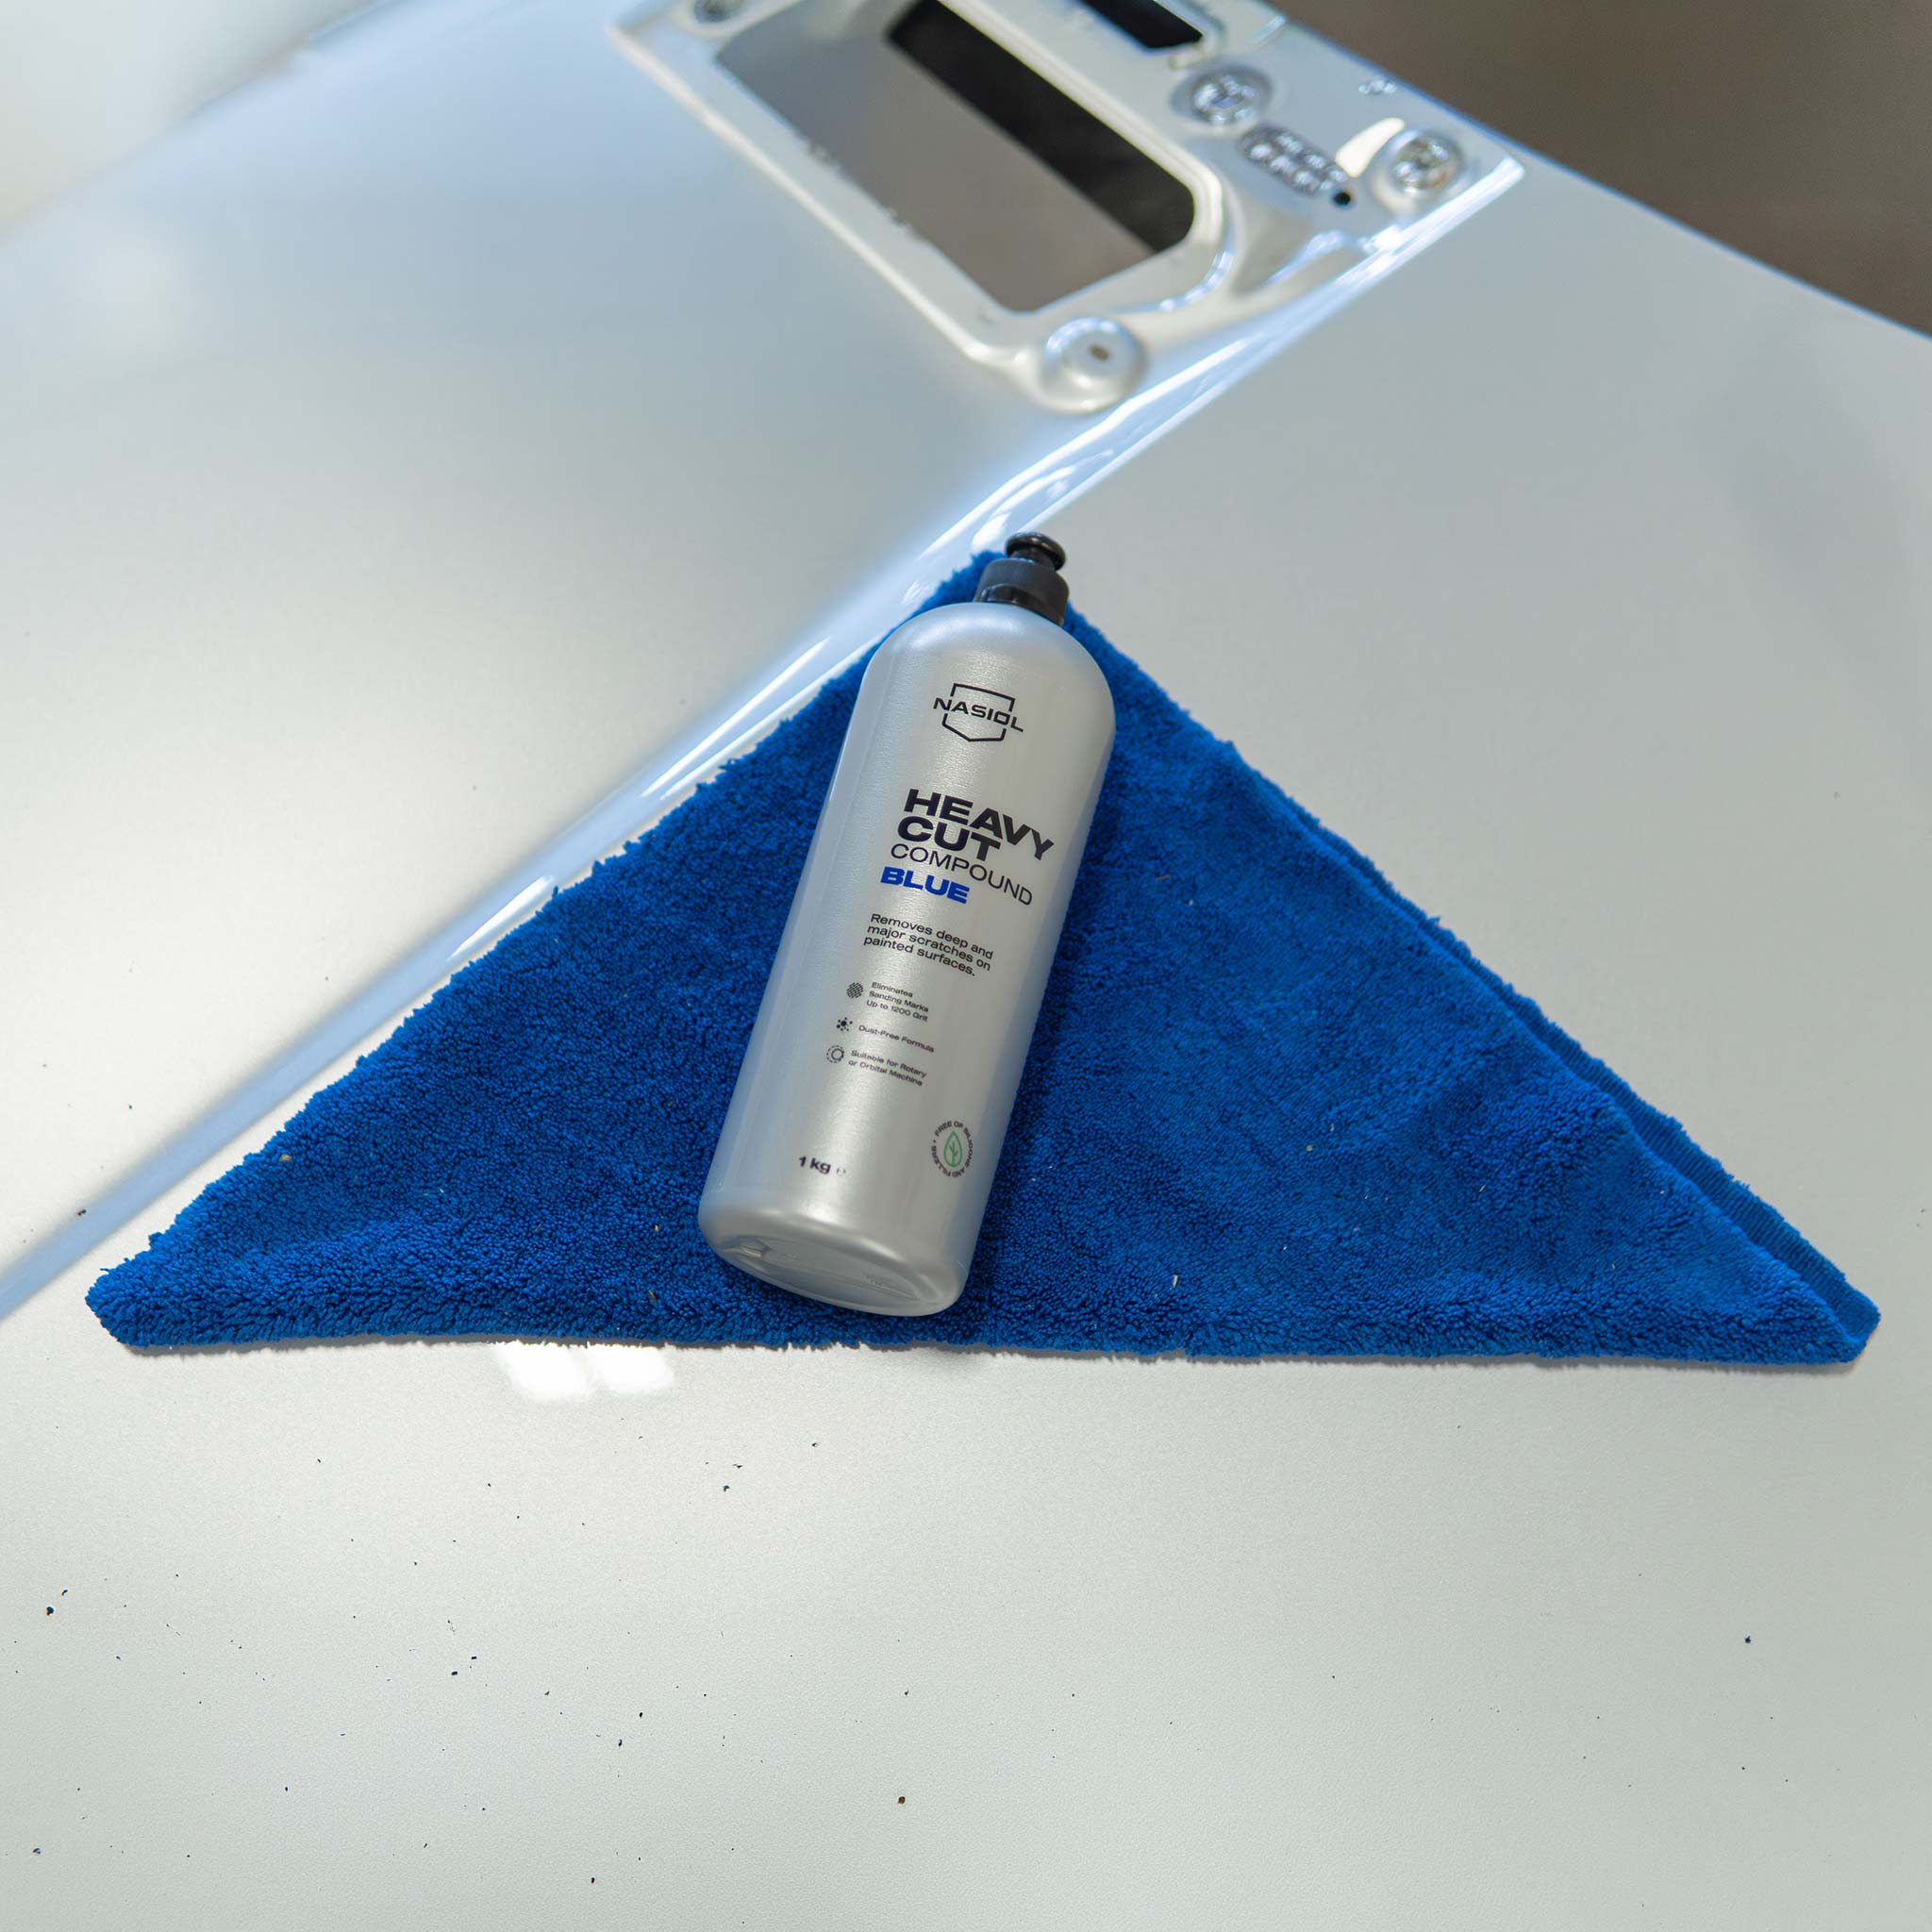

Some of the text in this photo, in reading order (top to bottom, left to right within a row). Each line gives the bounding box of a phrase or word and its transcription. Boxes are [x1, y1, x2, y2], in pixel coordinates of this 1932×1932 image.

[933, 697, 1024, 732] NASIOL
[897, 816, 1001, 861] CUT
[904, 789, 1054, 860] HEAVY
[880, 866, 970, 904] BLUE
[891, 843, 1033, 906] COMPOUND
[867, 924, 991, 971] major scratches on
[870, 913, 993, 959] Removes deep and
[863, 936, 975, 976] painted surfaces.
[869, 991, 928, 1012] Sanding Marks
[871, 981, 913, 998] Eliminates
[866, 1000, 878, 1009] Up
[891, 1006, 911, 1016] 1200
[912, 1011, 928, 1022] Grit
[858, 1024, 934, 1053] Dust-Free Formula
[851, 1050, 926, 1078] Suitable for Rotary
[859, 1061, 887, 1074] Orbital
[889, 1070, 923, 1086] Machine
[934, 1120, 952, 1137] FREE
[799, 1156, 807, 1167] 1
[809, 1157, 831, 1174] kg
